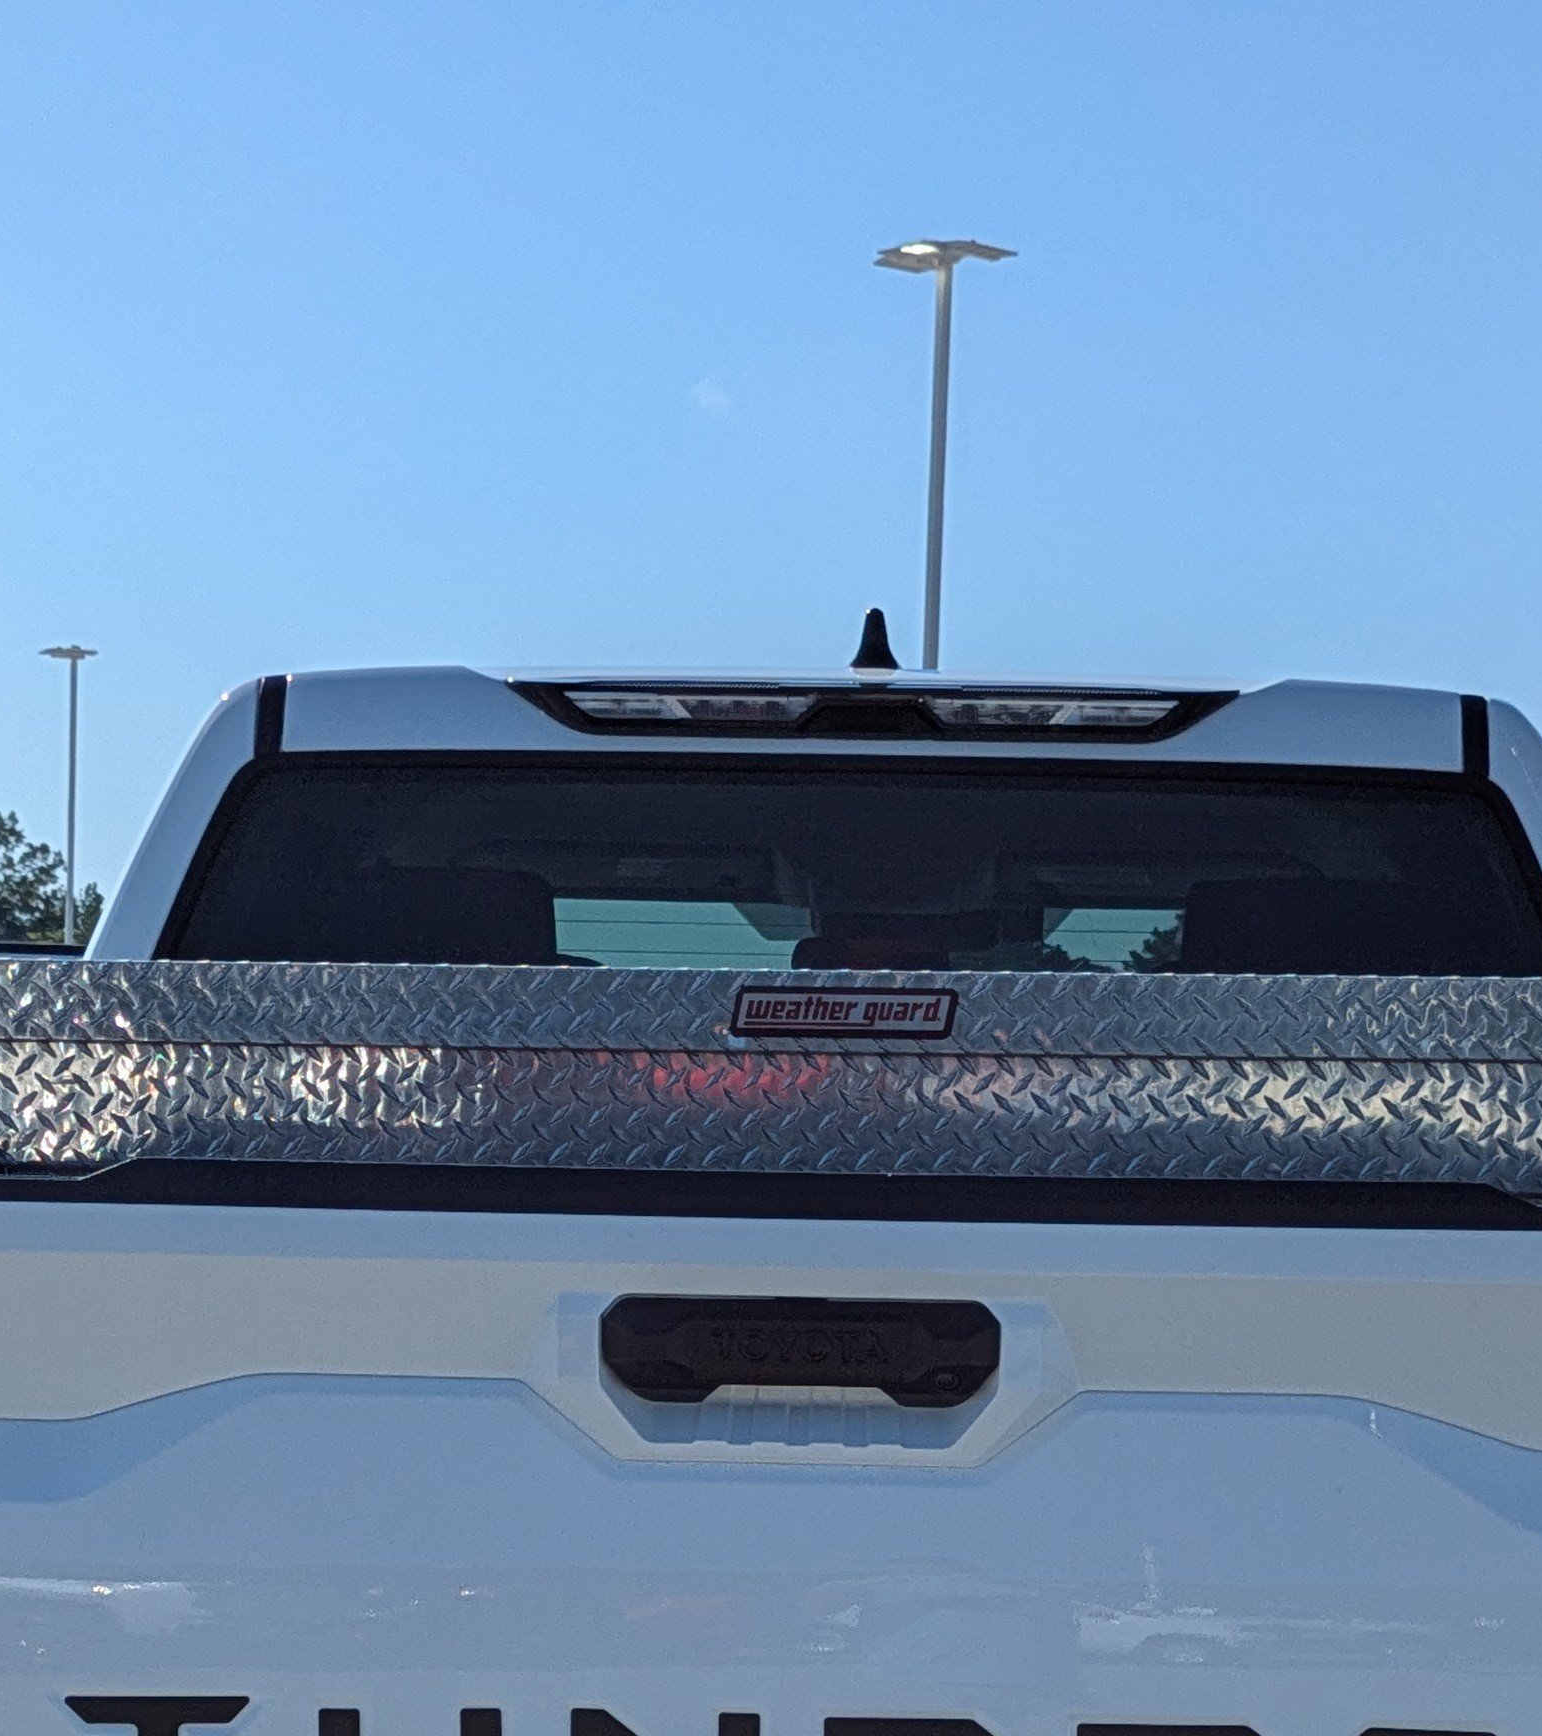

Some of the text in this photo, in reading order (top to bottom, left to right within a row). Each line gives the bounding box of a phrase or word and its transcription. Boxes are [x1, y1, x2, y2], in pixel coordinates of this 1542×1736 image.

[745, 997, 941, 1026] weather guard
[713, 1327, 889, 1365] TOYOTA
